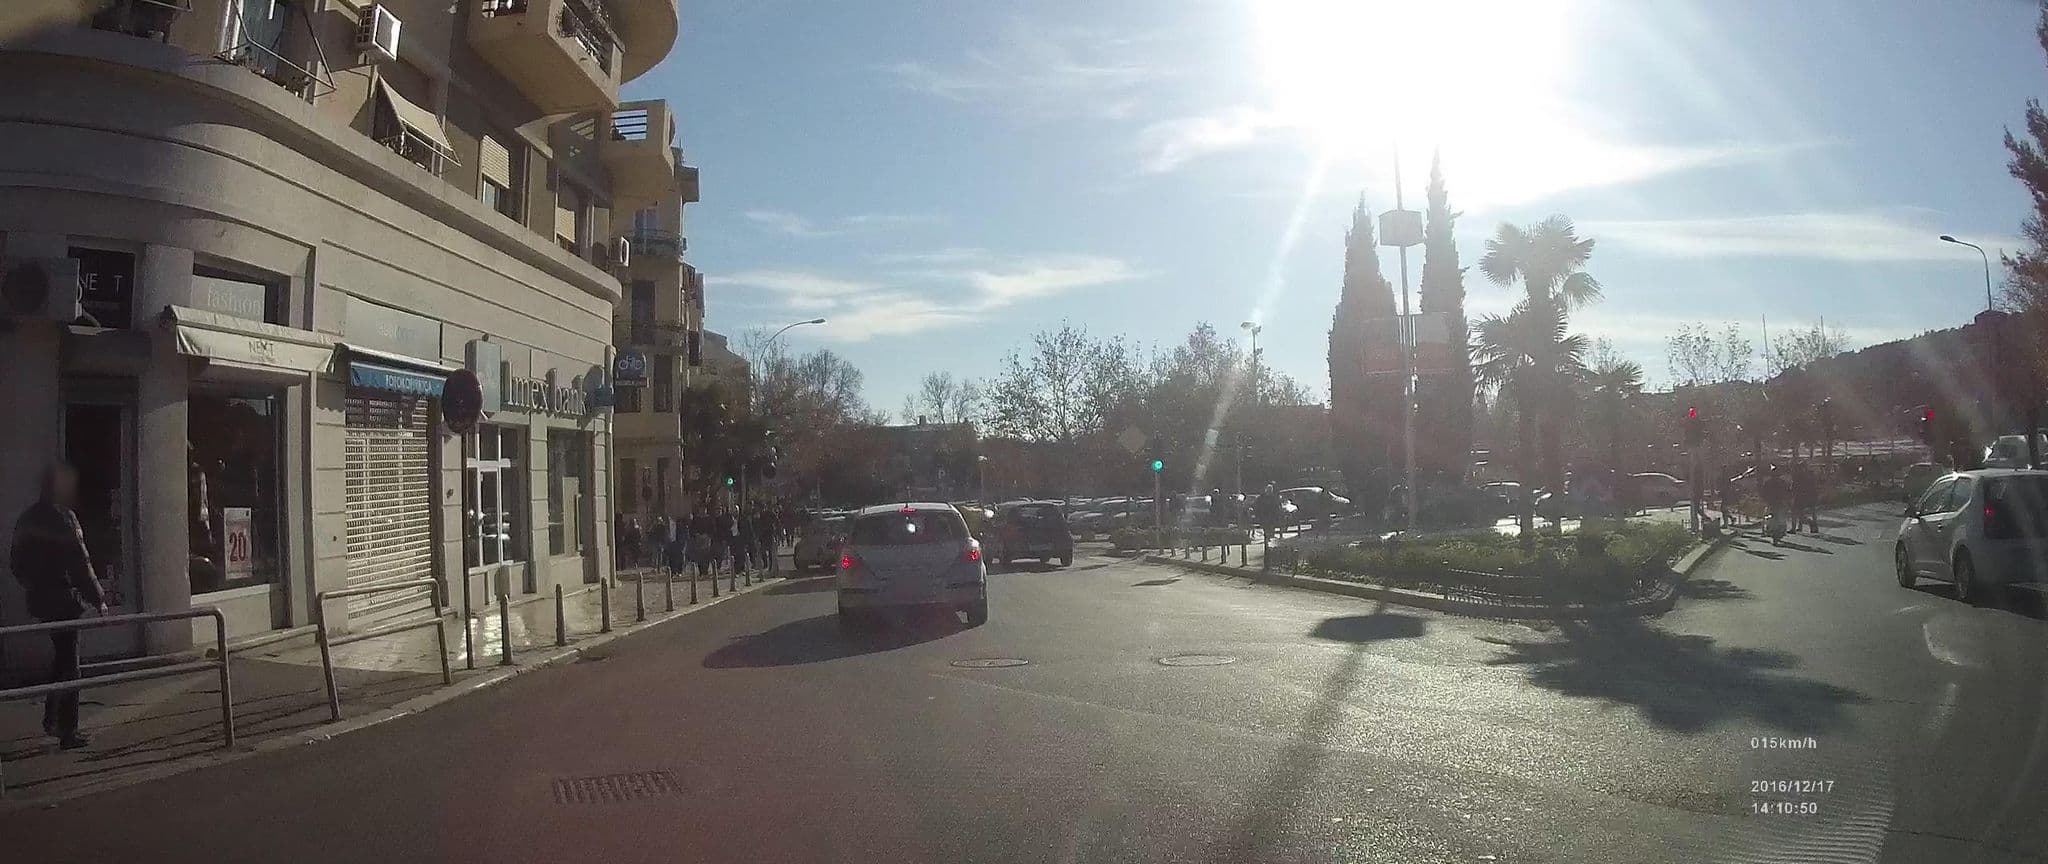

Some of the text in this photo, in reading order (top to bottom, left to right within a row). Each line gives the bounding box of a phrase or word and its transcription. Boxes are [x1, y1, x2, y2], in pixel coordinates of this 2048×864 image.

[207, 283, 263, 317] fashion
[248, 341, 275, 357] NEXT
[553, 367, 588, 416] bank
[229, 531, 247, 562] 20
